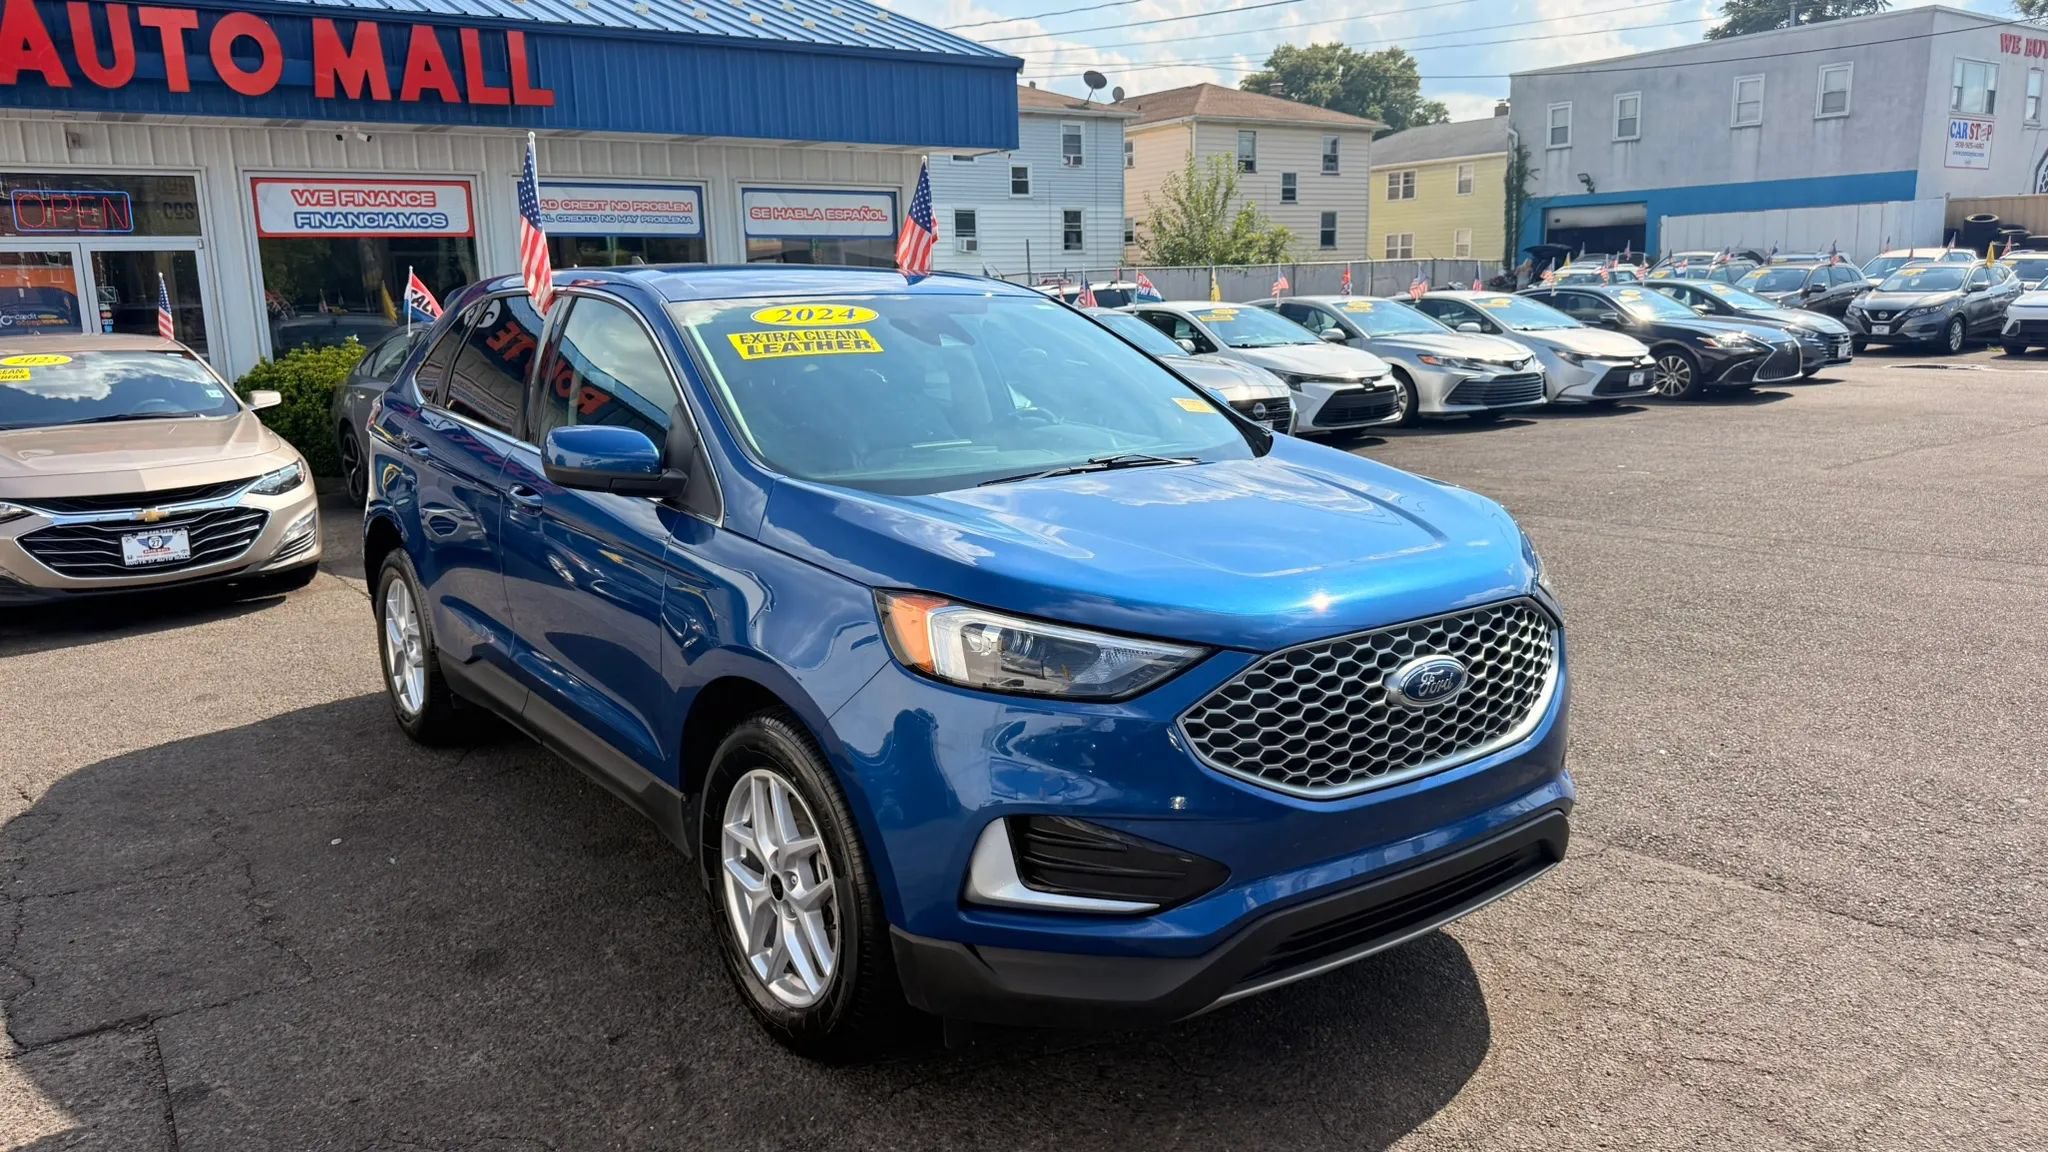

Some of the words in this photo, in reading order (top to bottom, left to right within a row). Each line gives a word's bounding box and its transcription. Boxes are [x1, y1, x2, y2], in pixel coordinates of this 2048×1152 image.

[2000, 33, 2021, 54] WE
[0, 0, 284, 96] AUTO
[312, 18, 555, 107] MALL
[1950, 121, 1968, 139] CAR
[291, 189, 336, 207] WE
[339, 190, 436, 207] FINANCE
[540, 200, 559, 211] AD
[561, 200, 608, 211] CREDIT
[610, 201, 631, 211] NO
[632, 201, 693, 213] PROBLEM
[17, 194, 129, 229] OPEN
[541, 214, 553, 223] AL
[556, 214, 599, 223] CREDITO
[600, 215, 616, 223] NO
[618, 215, 638, 223] HAY
[640, 215, 693, 224] PROBLEMA
[750, 207, 772, 219] SE
[773, 207, 823, 220] HABLA
[826, 205, 888, 221] ESPAÑOL
[295, 212, 448, 229] FINANCIAMOS
[411, 289, 437, 317] SAL
[776, 308, 856, 322] 2024
[740, 331, 799, 344] EXTRA
[804, 329, 859, 342] CLEAN
[747, 339, 872, 356] LEATHER
[1418, 669, 1454, 697] Ford
